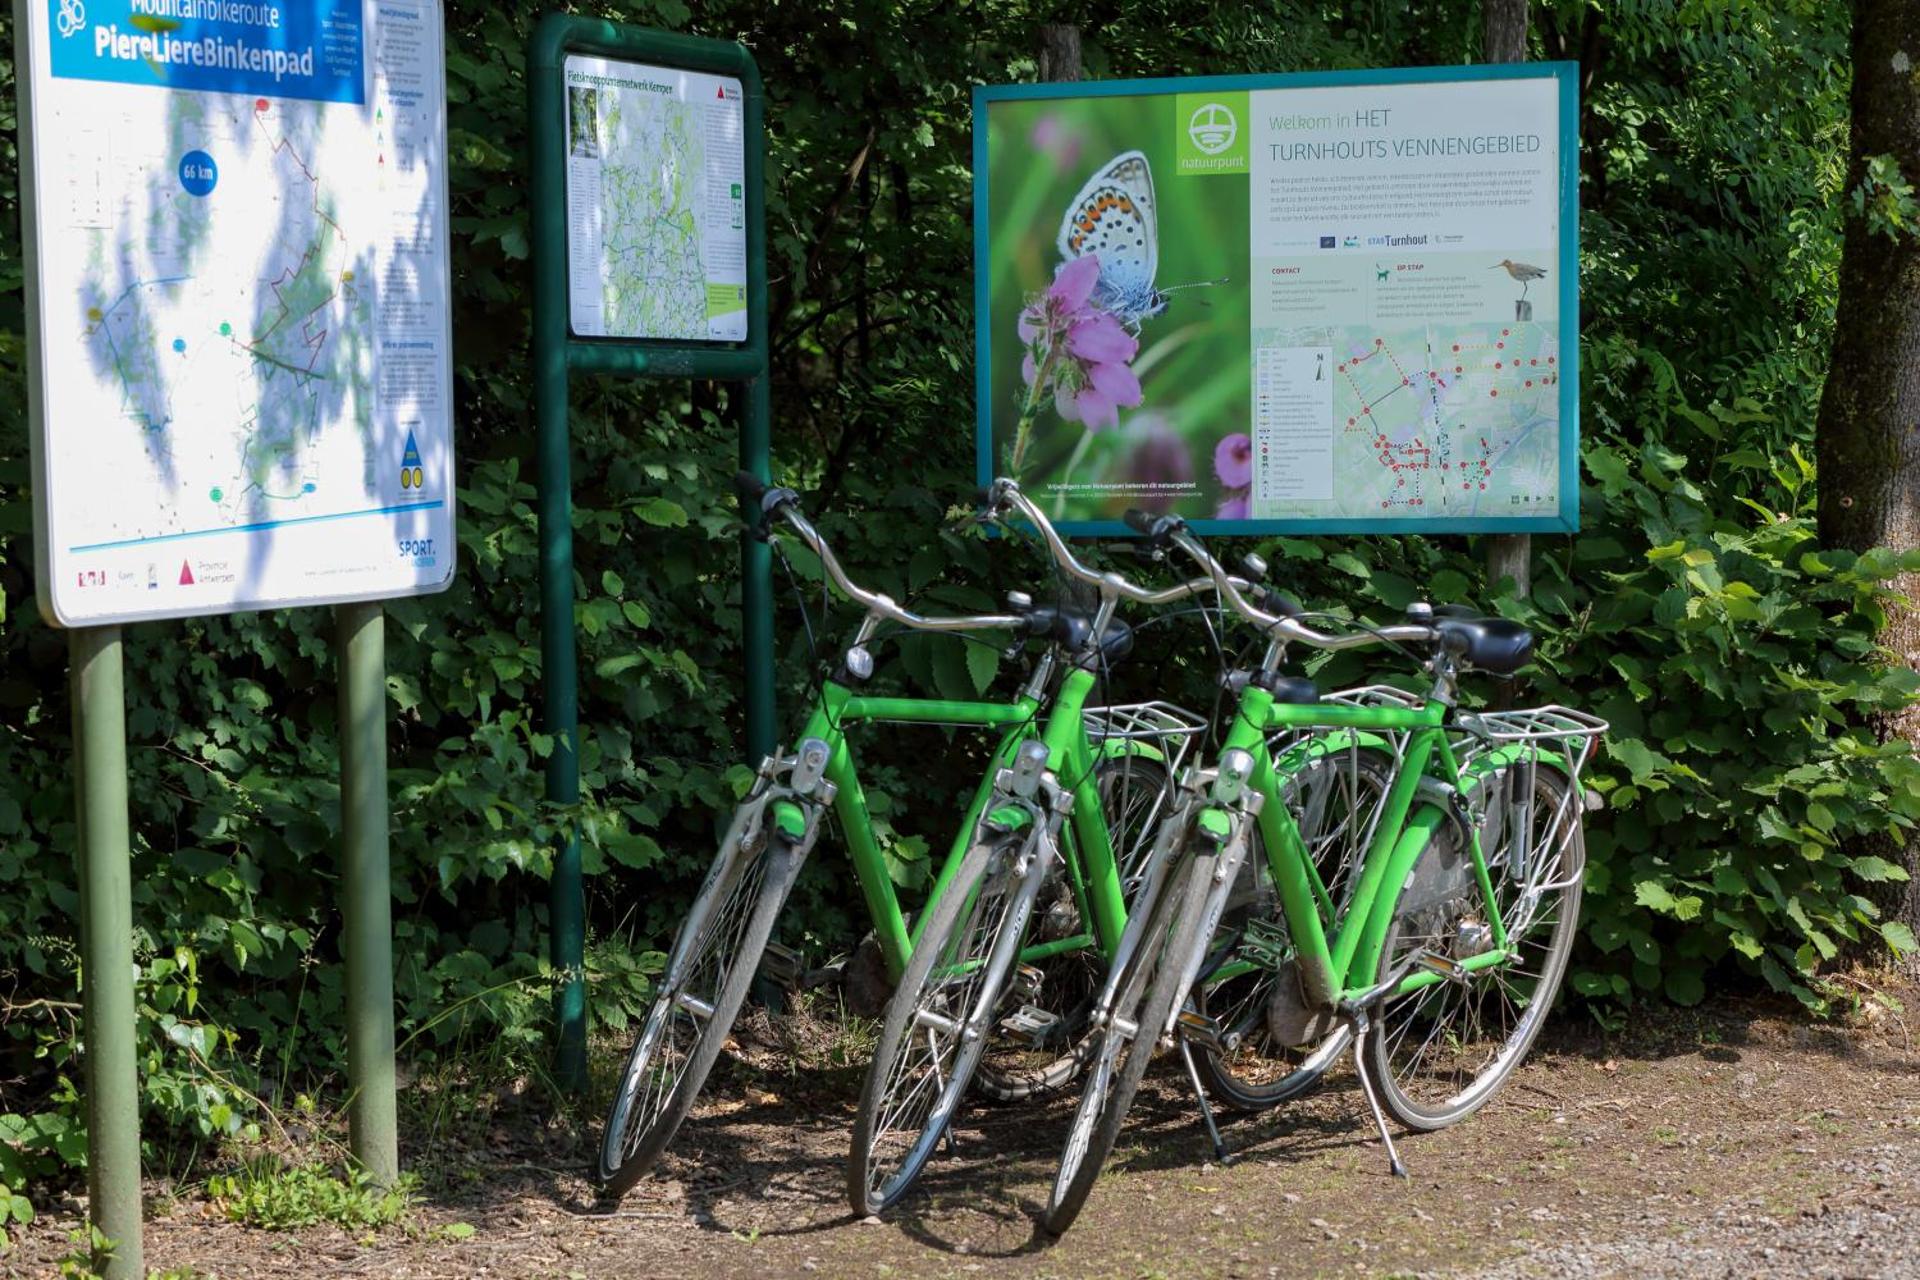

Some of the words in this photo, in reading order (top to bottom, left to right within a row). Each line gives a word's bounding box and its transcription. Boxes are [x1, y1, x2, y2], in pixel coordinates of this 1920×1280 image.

[131, 0, 280, 28] Mountainbikeroute
[94, 24, 314, 82] PiereLiereBinkenpad
[1269, 114, 1332, 130] Welkom
[1336, 112, 1351, 129] in
[1355, 108, 1392, 127] HET
[1269, 140, 1388, 161] TURNHOUTS
[1392, 135, 1541, 158] VENNENGEBIED
[1182, 155, 1245, 170] natuurpunt
[184, 164, 196, 179] 66
[198, 163, 213, 180] km
[1384, 234, 1428, 247] Turnhout
[1271, 267, 1301, 275] CONTACT
[1316, 353, 1324, 361] N
